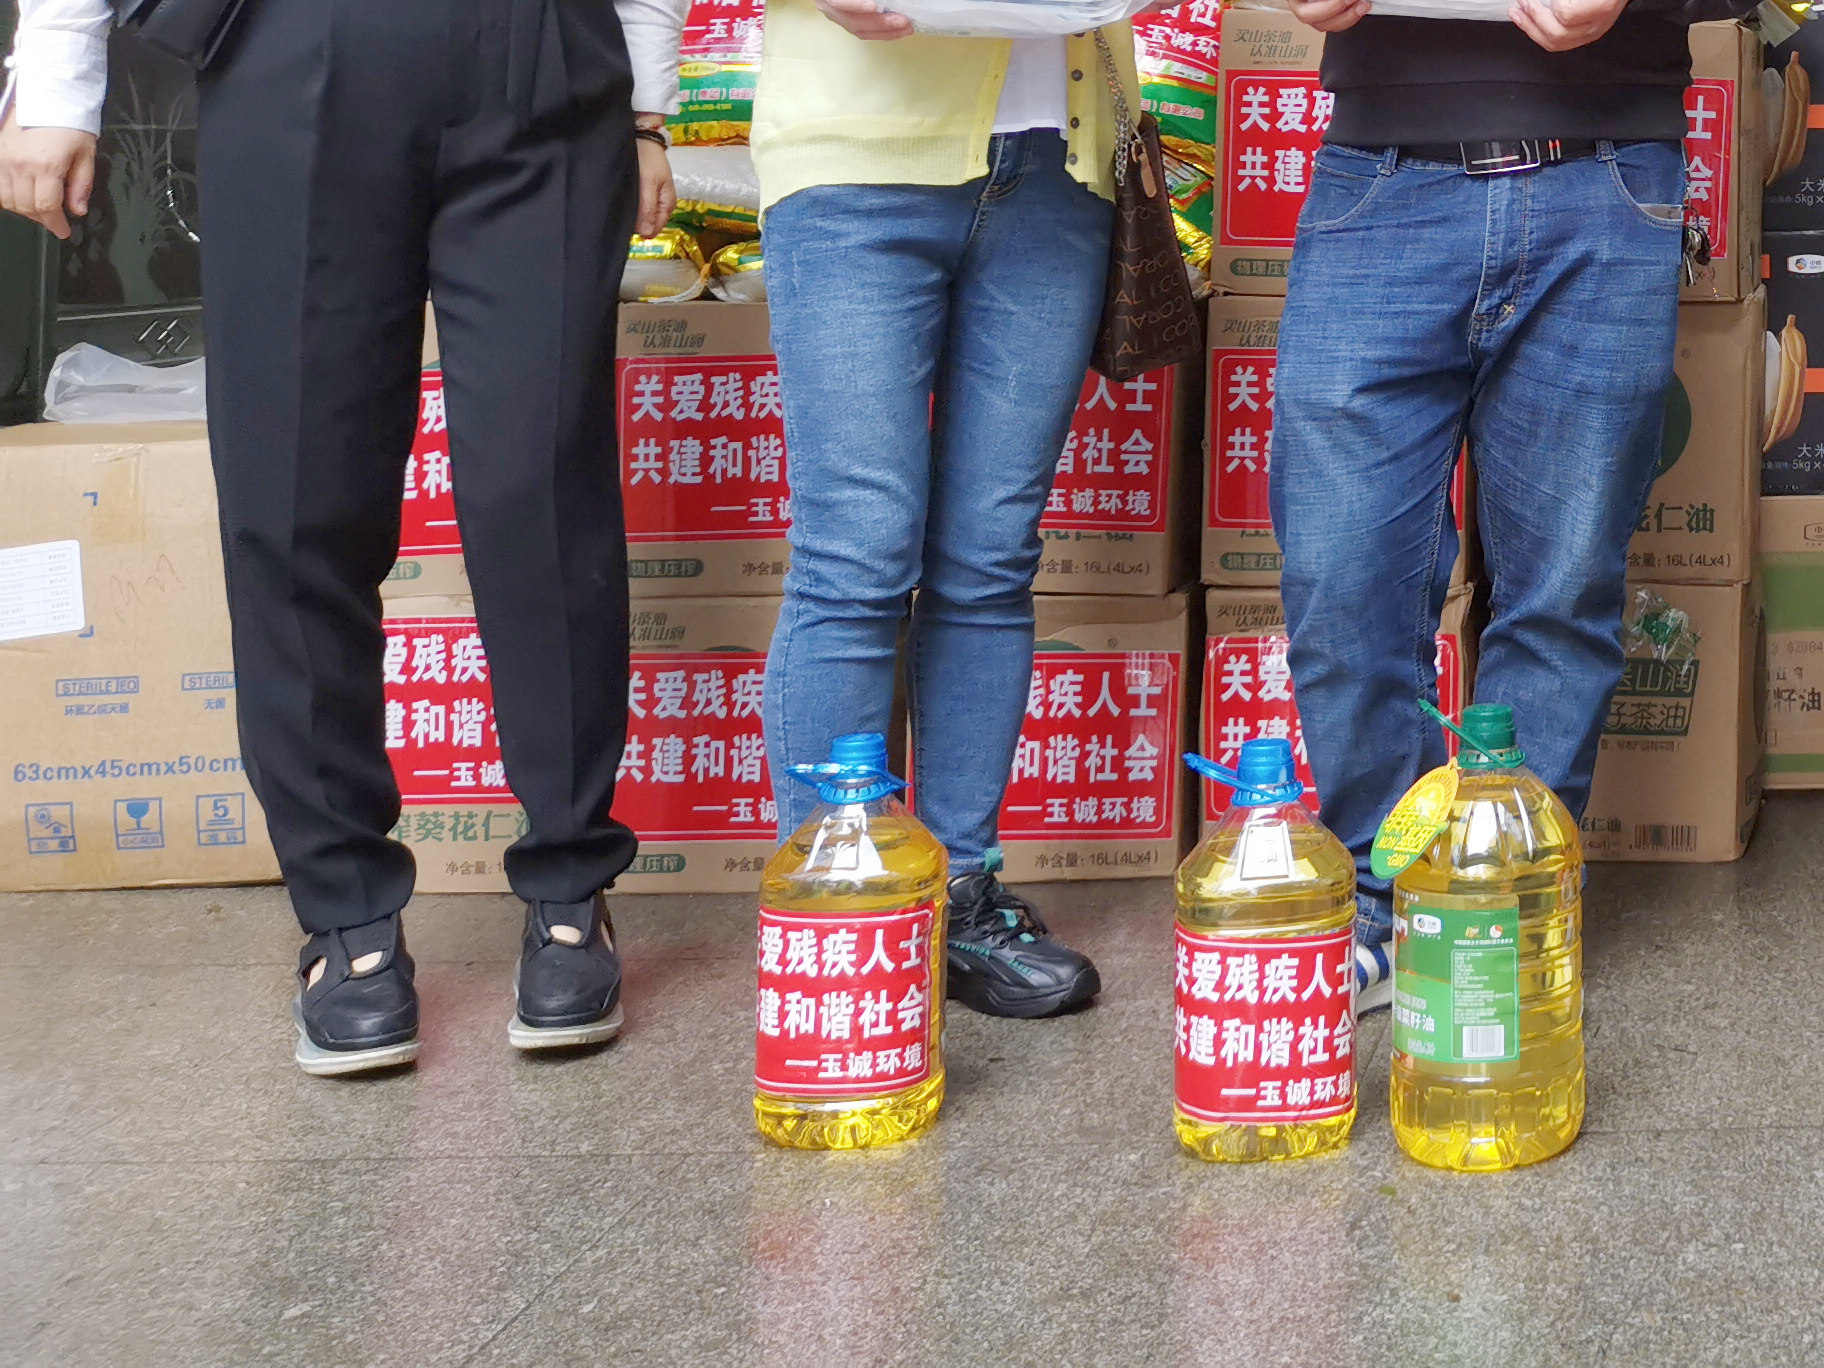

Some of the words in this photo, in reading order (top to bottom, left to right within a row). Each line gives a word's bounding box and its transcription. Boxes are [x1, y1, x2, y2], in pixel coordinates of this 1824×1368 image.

[631, 370, 783, 422] 关爱残疾
[630, 434, 784, 486] 共建和谐
